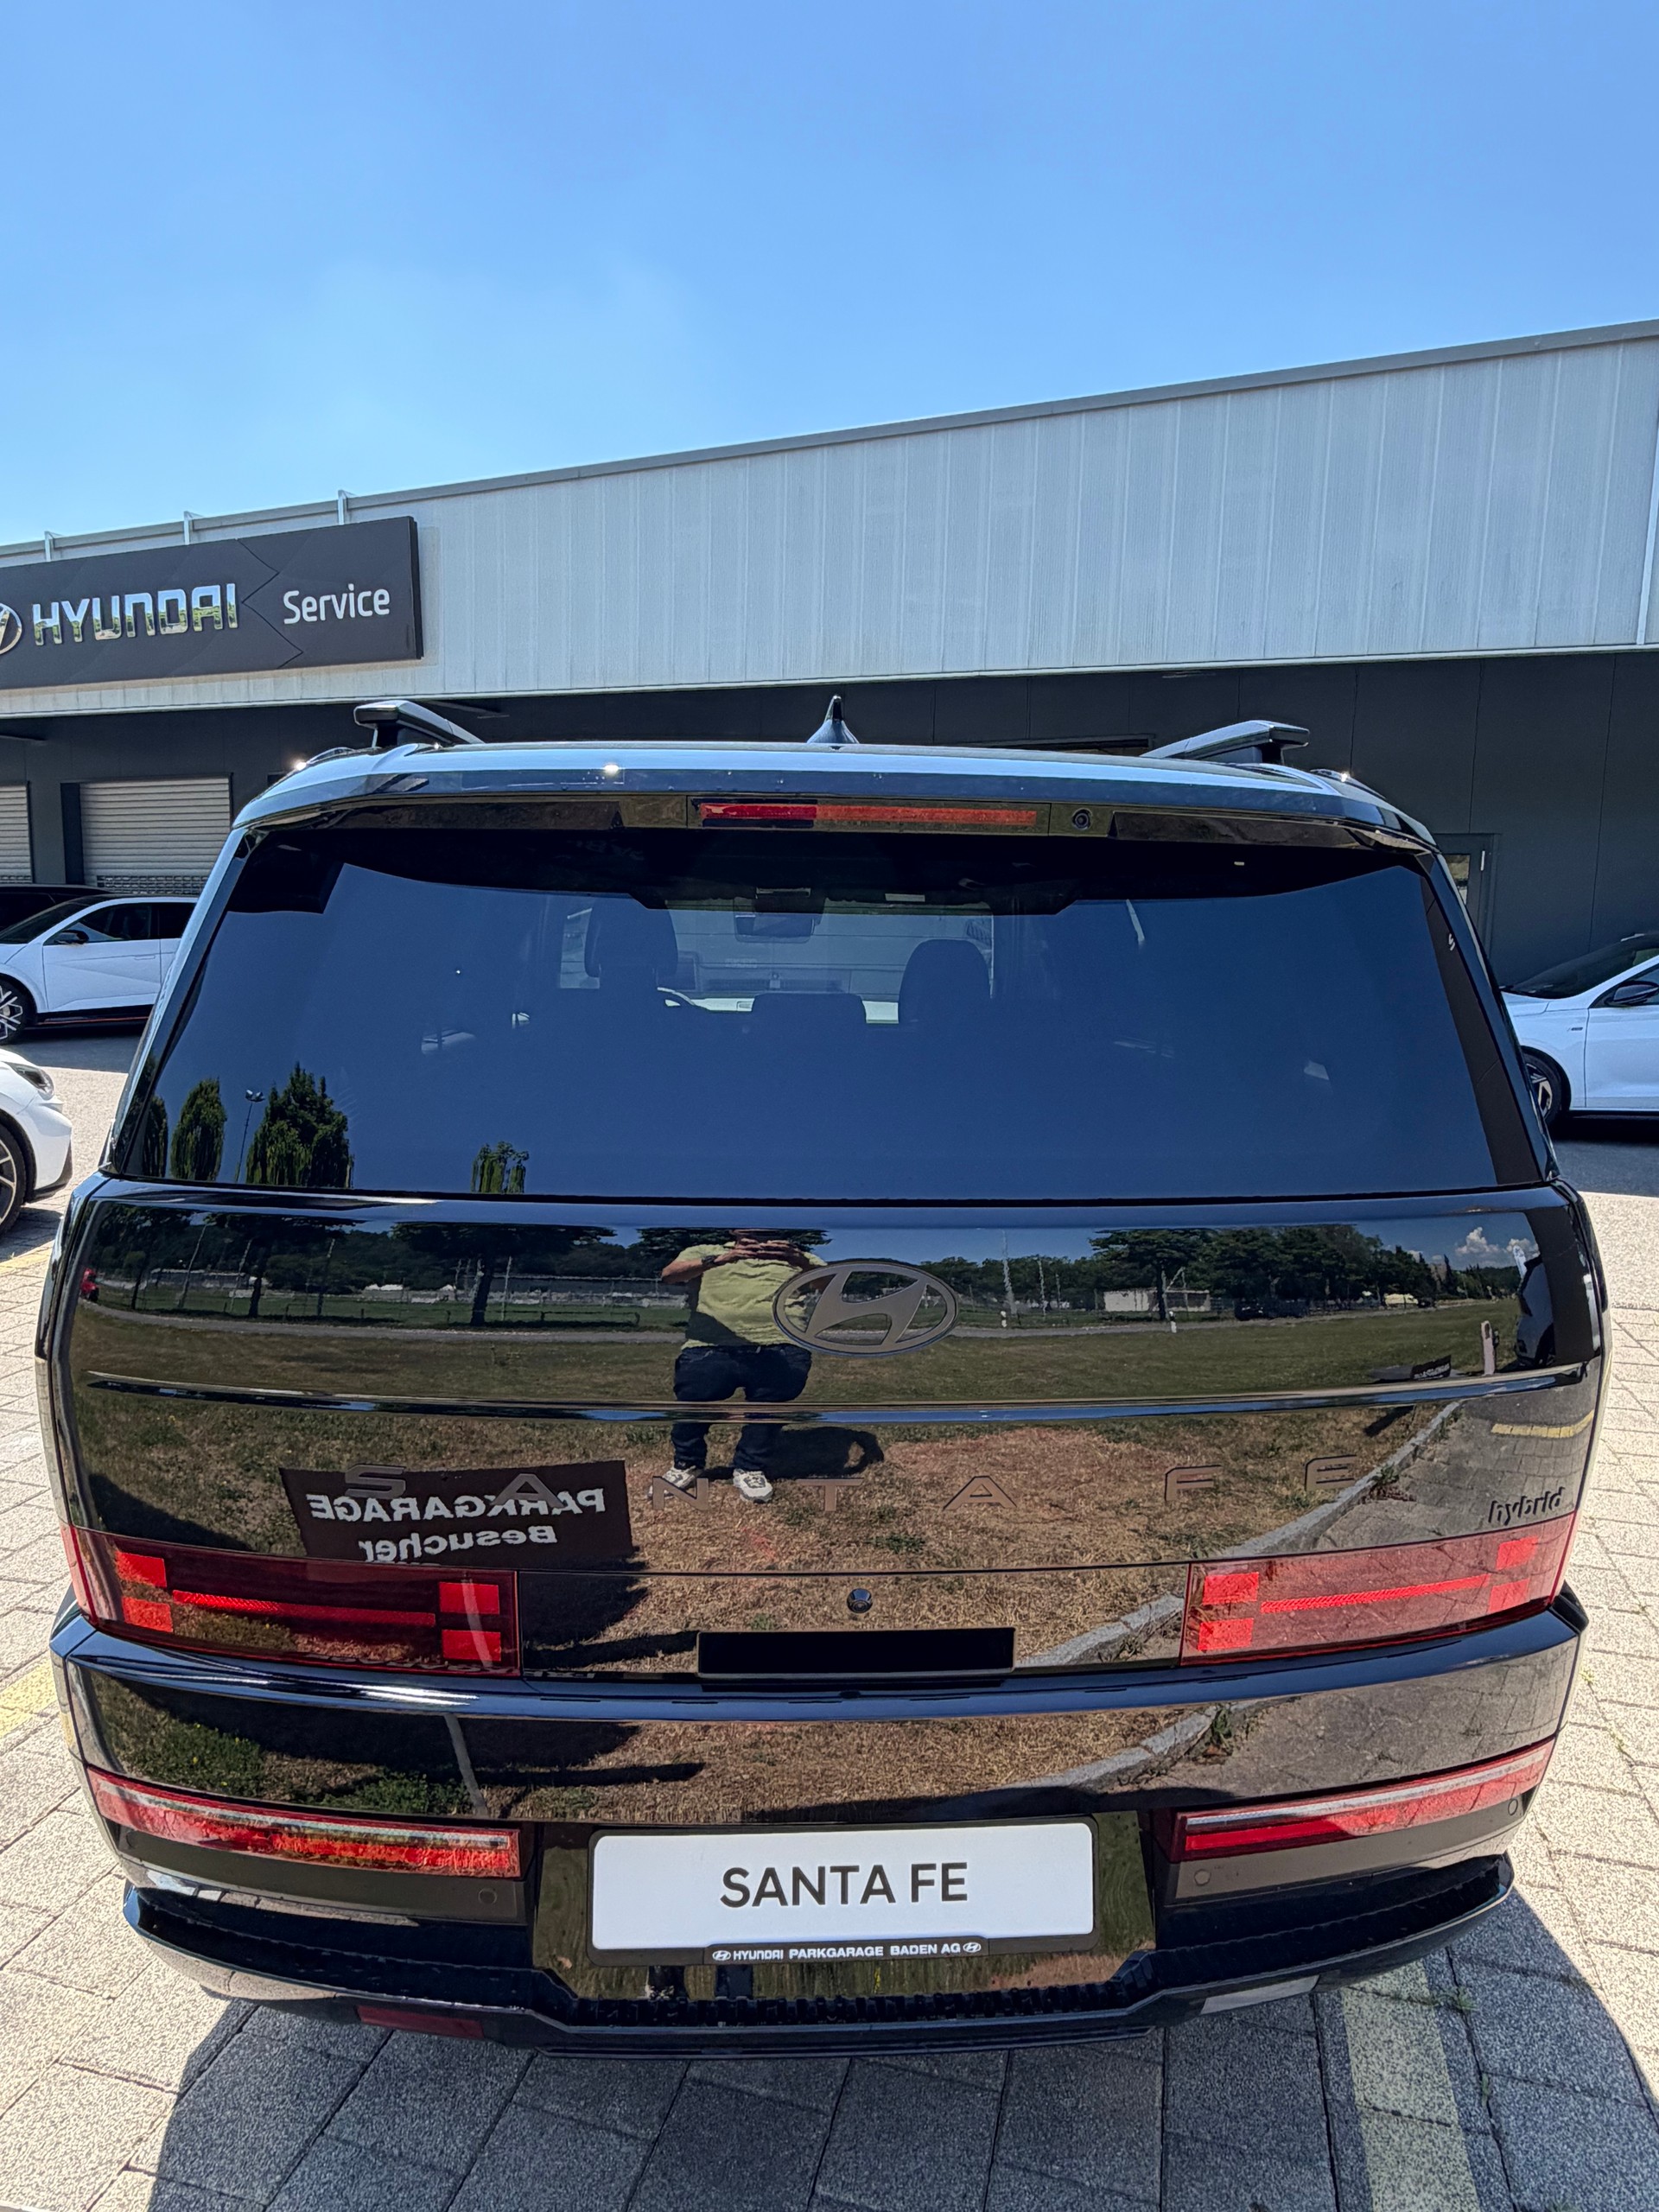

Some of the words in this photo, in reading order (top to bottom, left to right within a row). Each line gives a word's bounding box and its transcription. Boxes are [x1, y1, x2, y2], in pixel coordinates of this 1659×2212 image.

[33, 582, 238, 646] HYUNDAI
[283, 584, 390, 625] Service
[1165, 1453, 1357, 1502] FE
[1488, 1486, 1565, 1526] hybrid
[720, 1865, 896, 1908] SANTA
[911, 1862, 968, 1903] FE
[734, 1949, 784, 1961] HYUNDAI
[789, 1946, 884, 1959] PARKGARAGE
[890, 1944, 938, 1955] BADEN
[941, 1943, 961, 1955] AG
